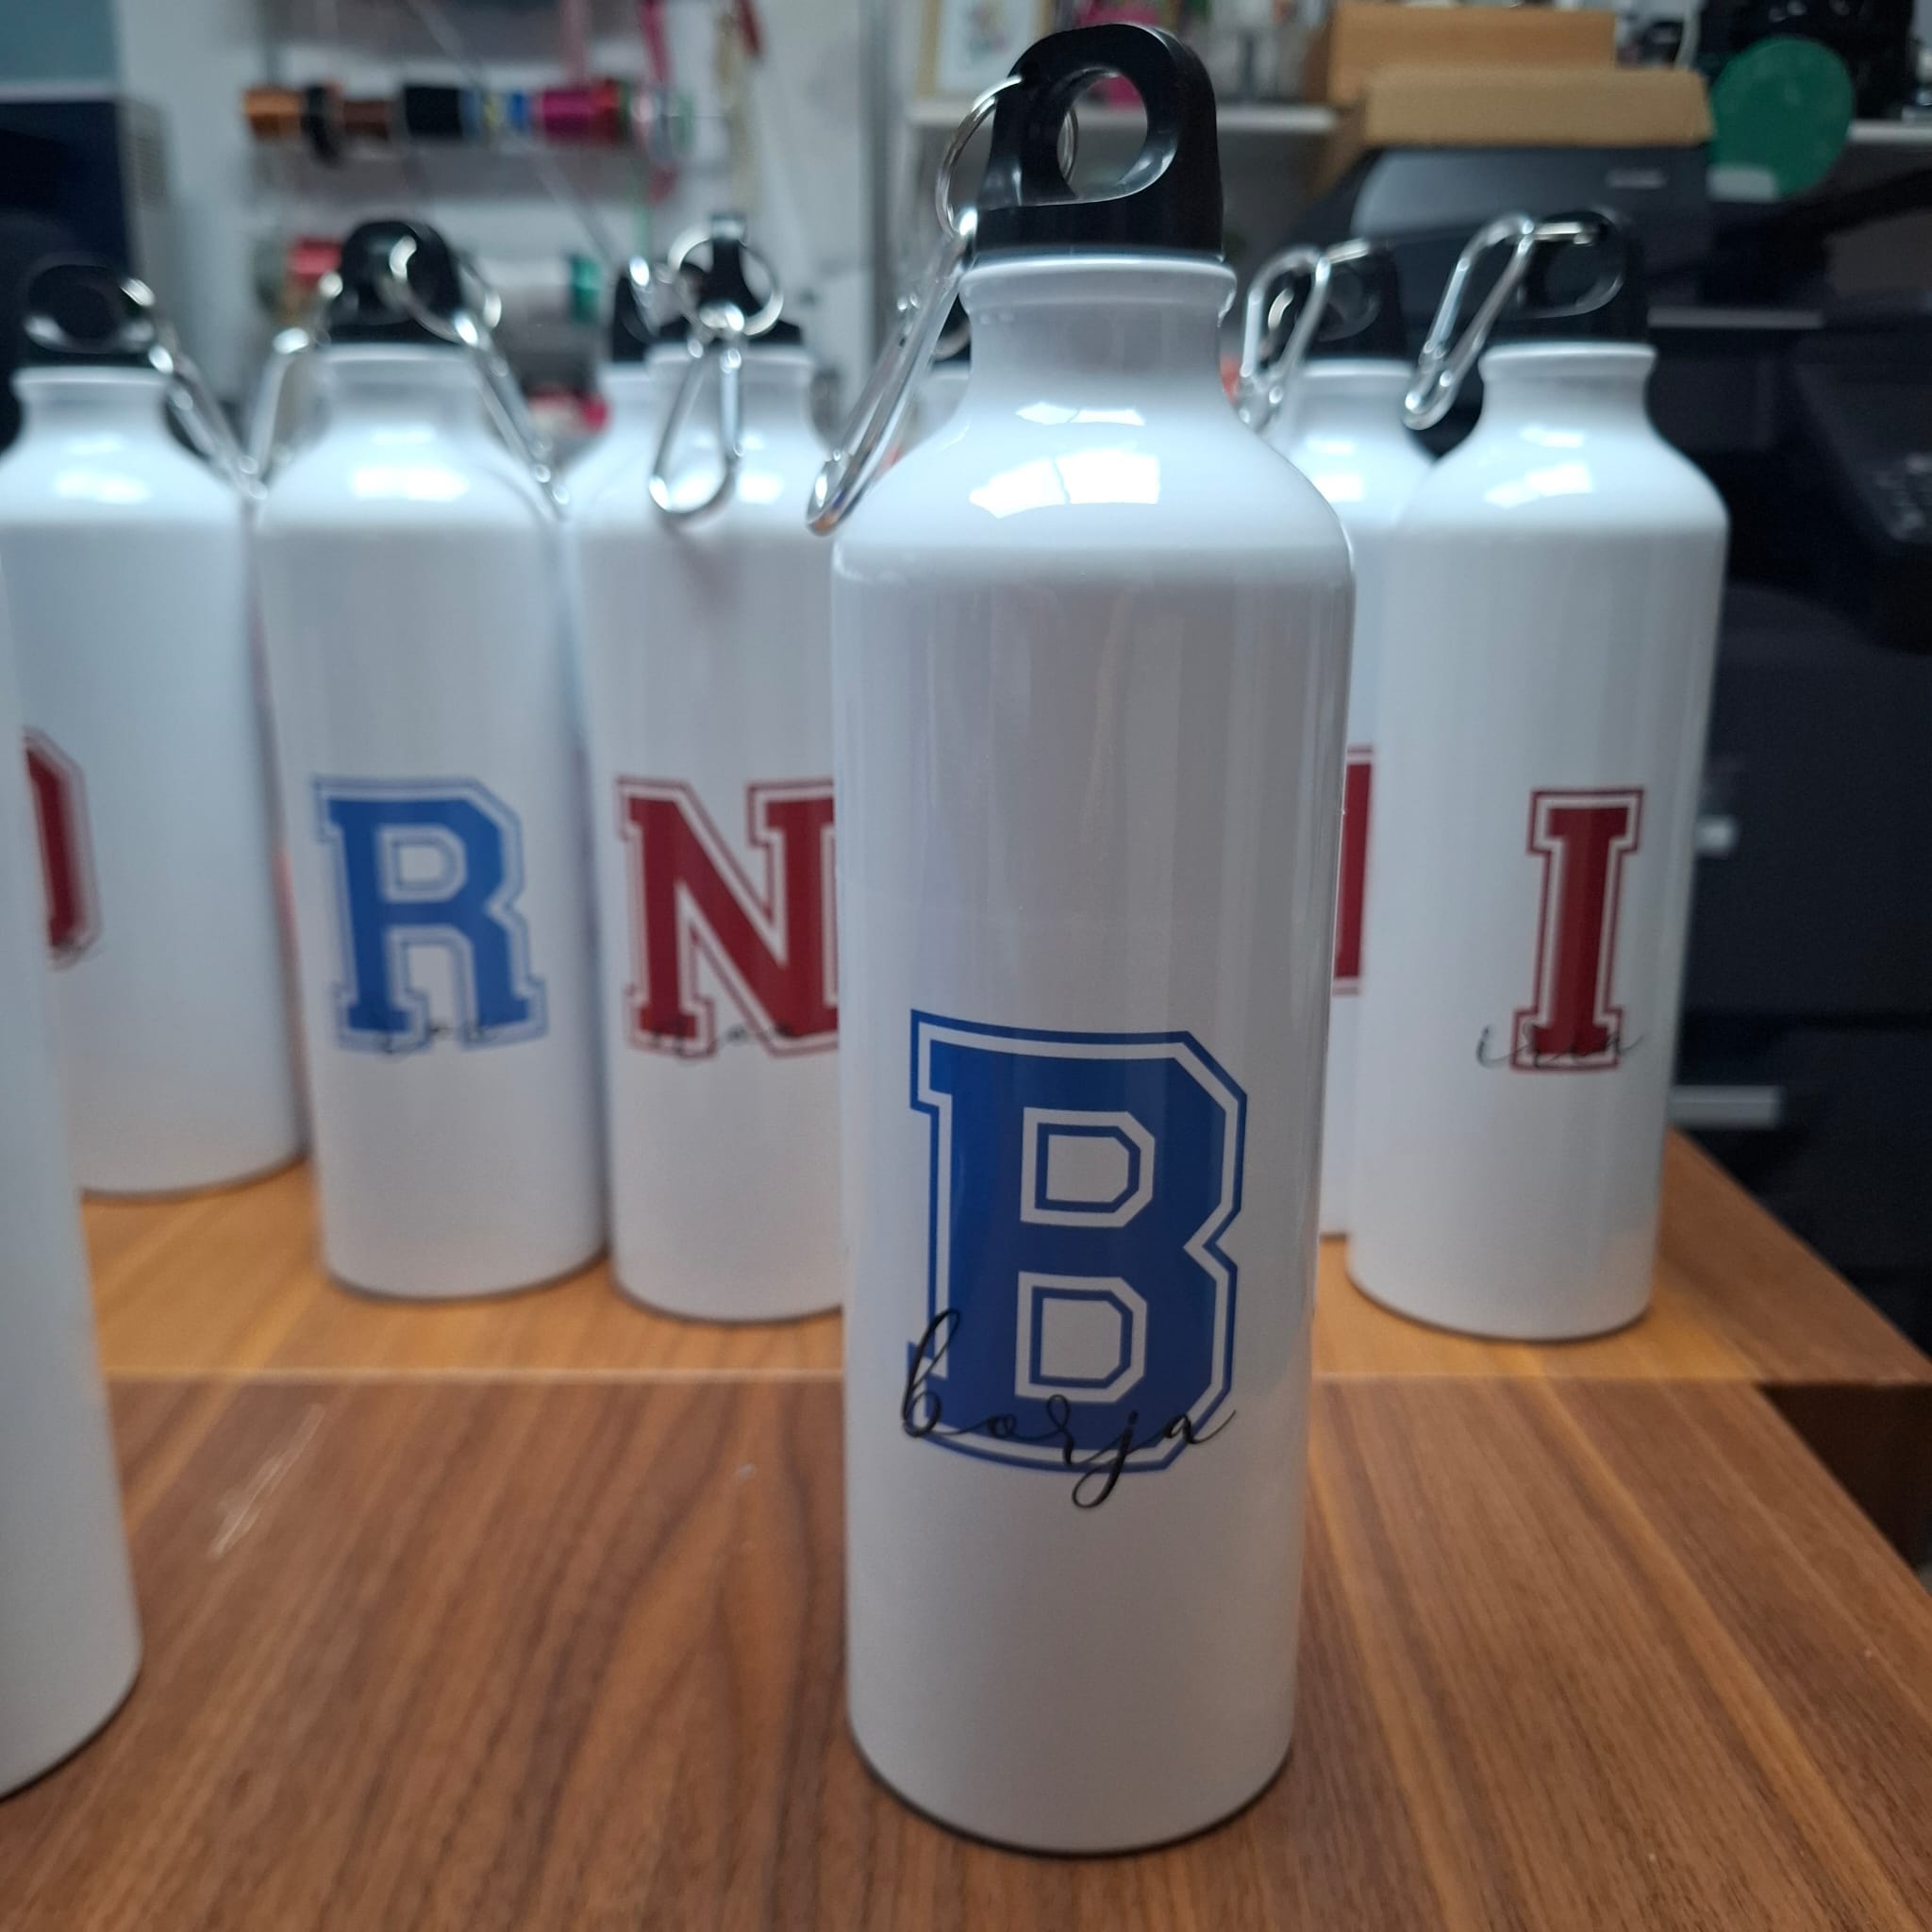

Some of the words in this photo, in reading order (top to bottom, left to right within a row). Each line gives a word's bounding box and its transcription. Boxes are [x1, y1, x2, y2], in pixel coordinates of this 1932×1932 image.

[311, 774, 548, 1055] R
[616, 774, 838, 1058] N
[1509, 786, 1644, 1074] I
[907, 1008, 1247, 1474] B
[900, 1307, 1237, 1509] borja
